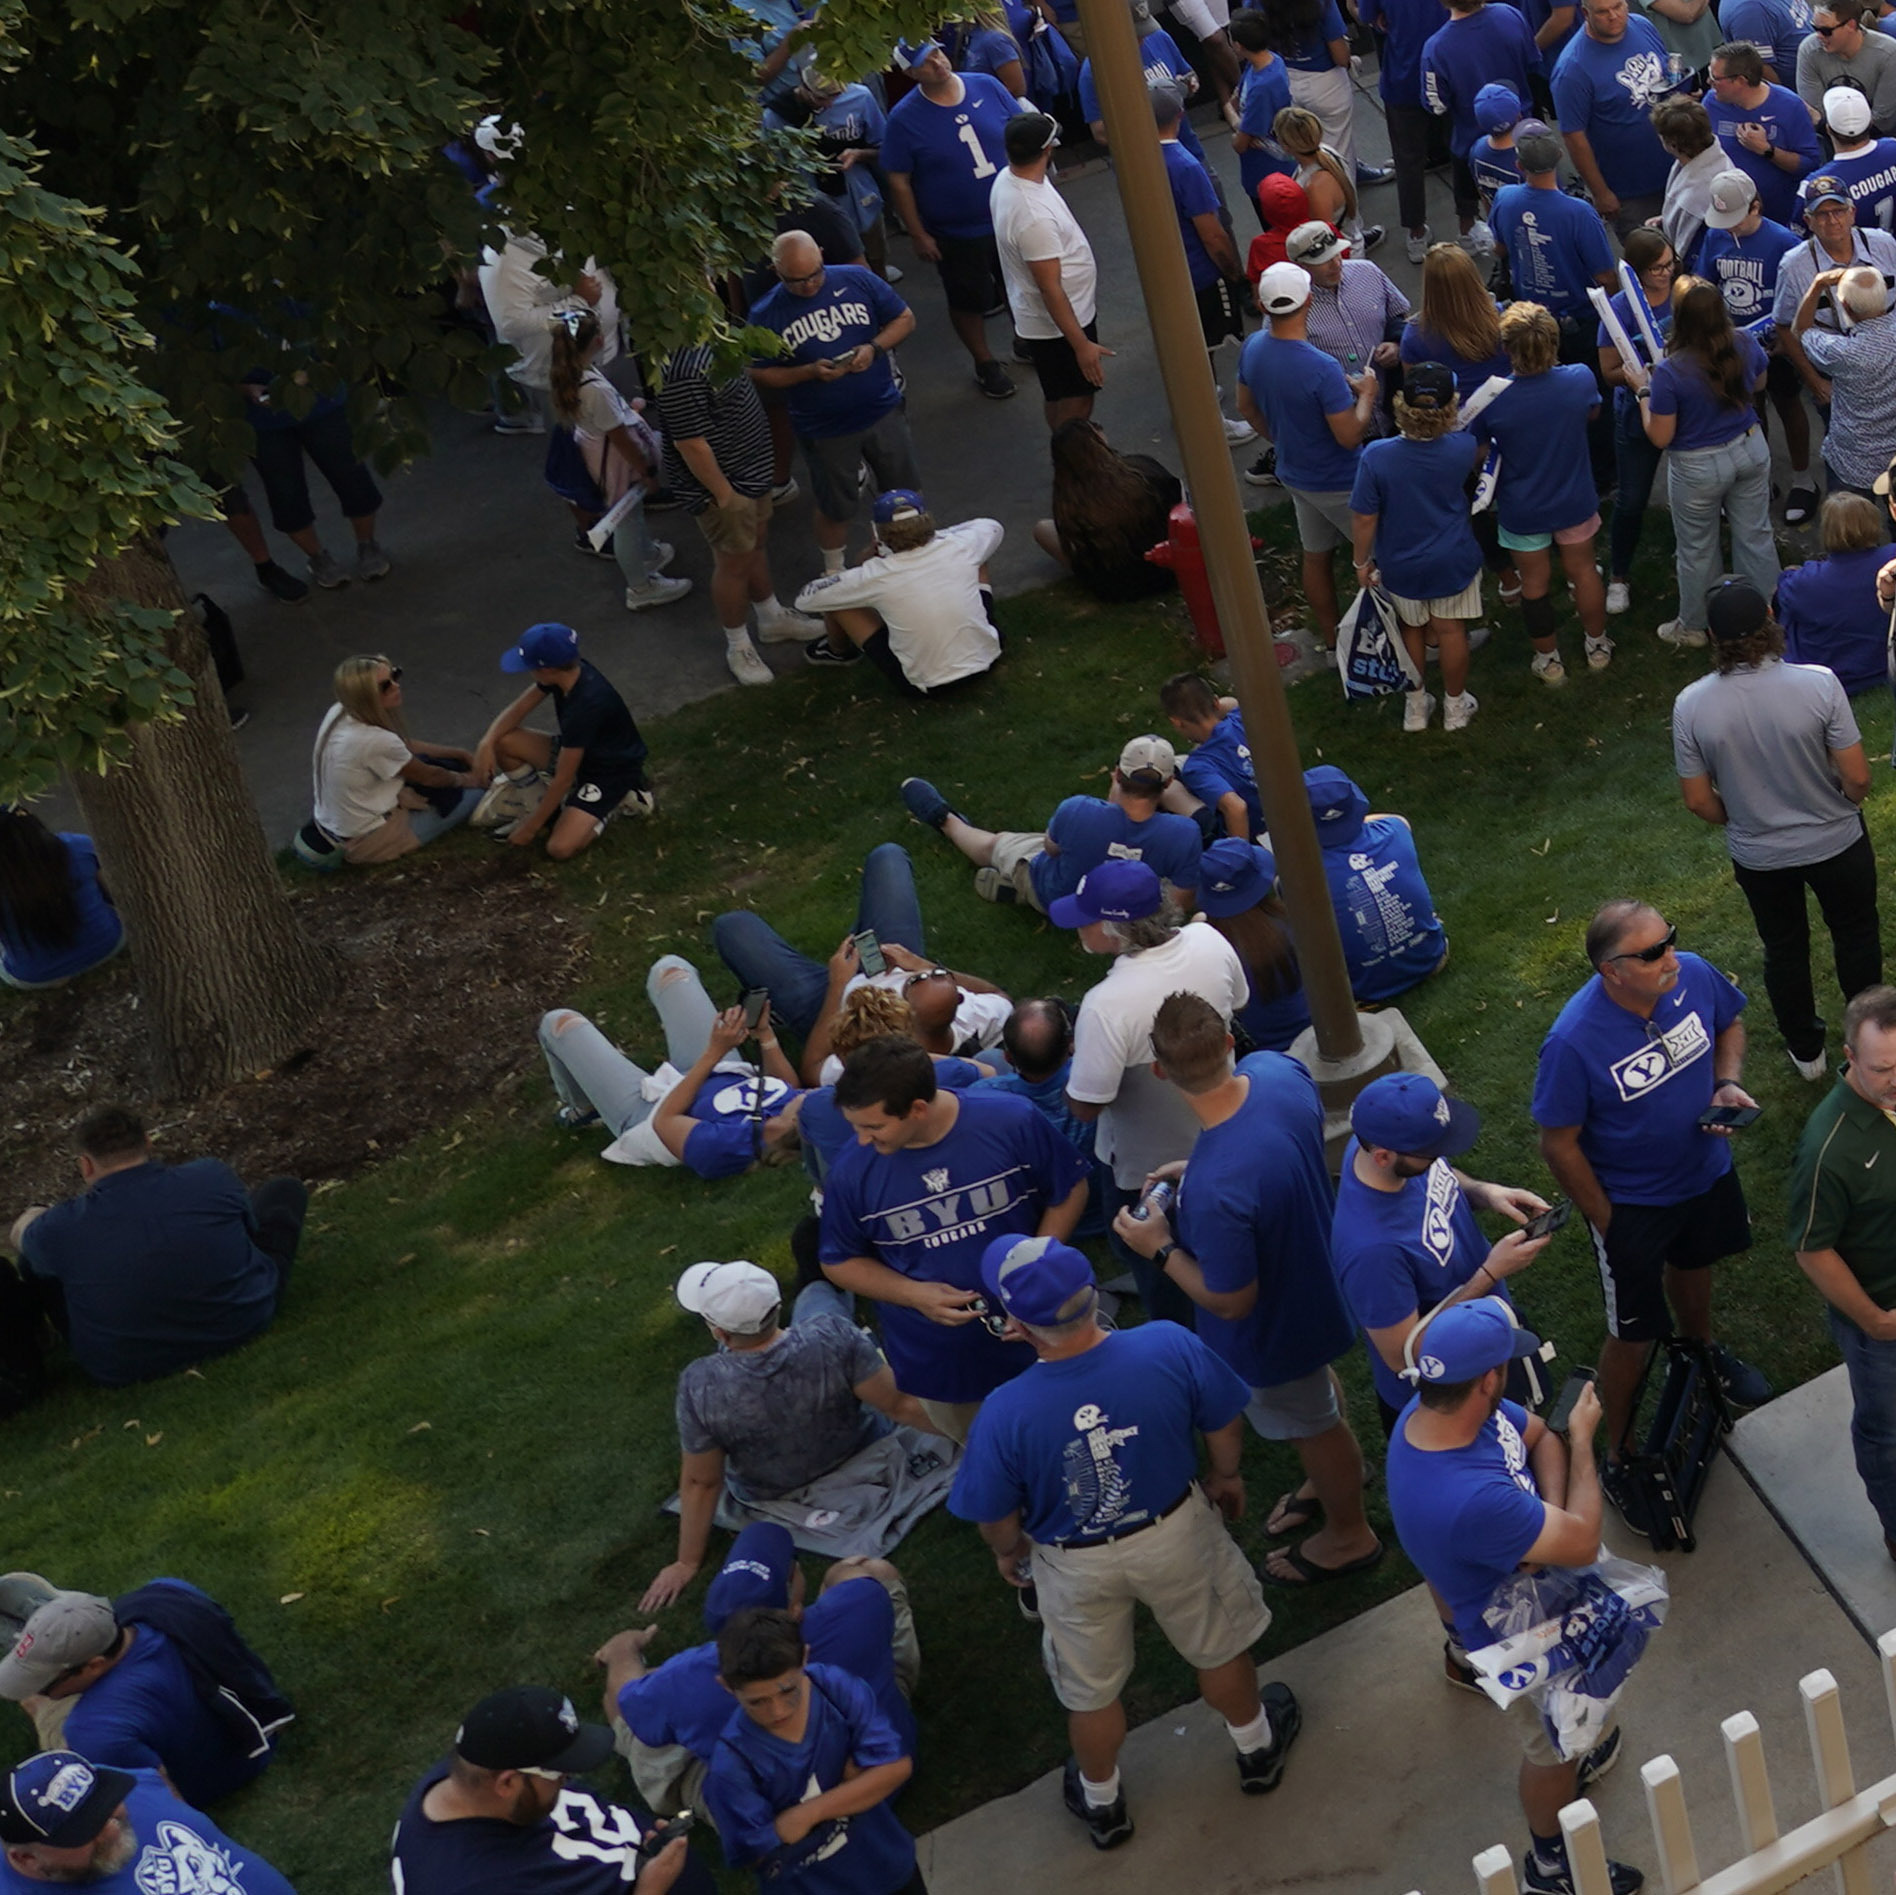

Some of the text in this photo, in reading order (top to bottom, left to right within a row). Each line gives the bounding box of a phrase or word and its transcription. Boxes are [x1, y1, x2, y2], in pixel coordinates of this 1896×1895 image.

[958, 123, 998, 180] 1
[1716, 258, 1764, 287] FOOTBALL
[783, 302, 871, 351] COUGARS
[883, 1179, 1011, 1242] BYU
[923, 1220, 988, 1250] COUGARS
[58, 1768, 91, 1808] BYU
[549, 1788, 642, 1881] 12
